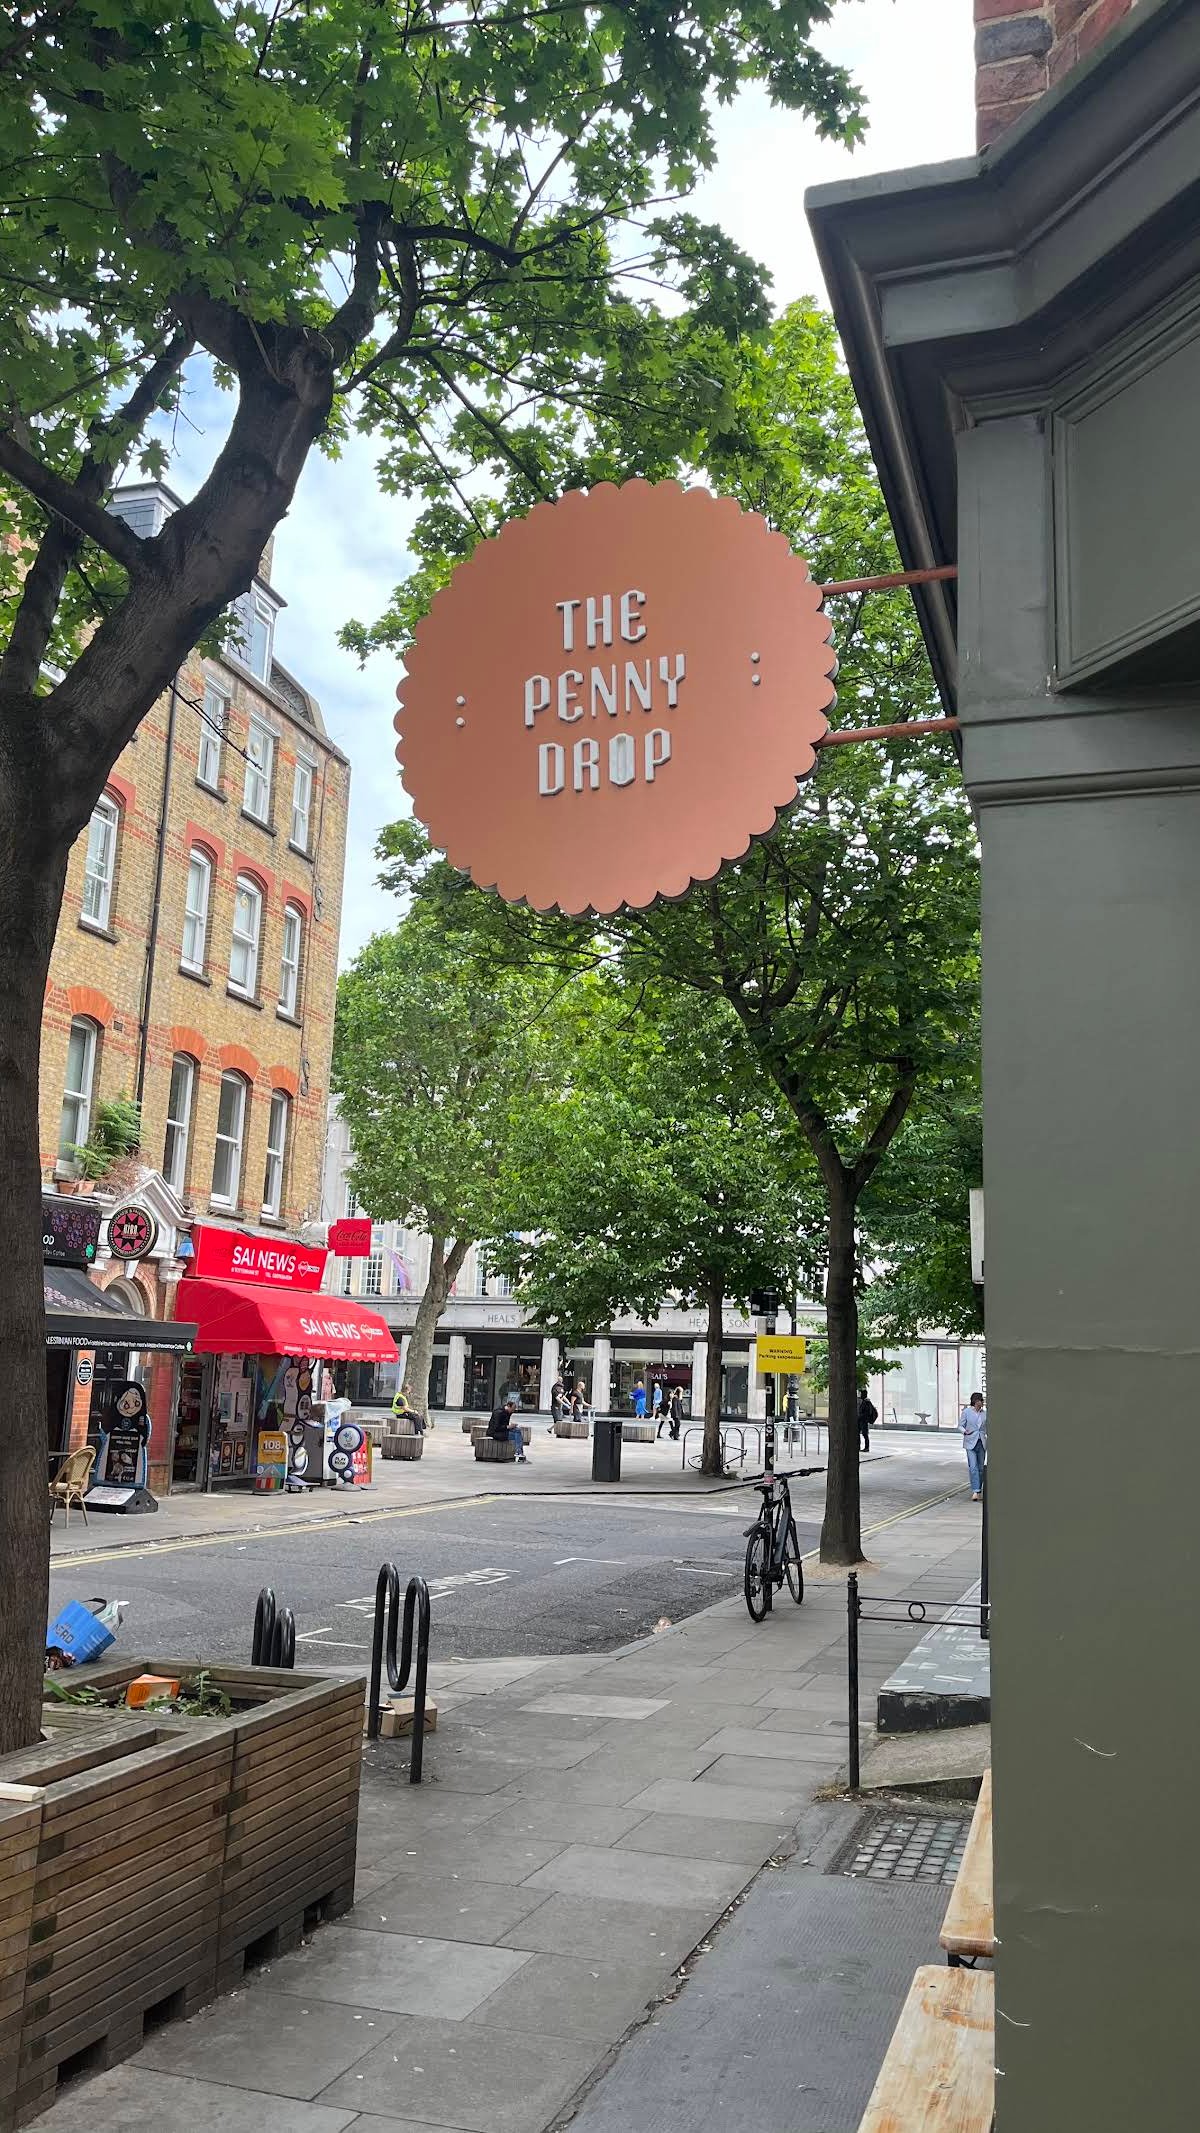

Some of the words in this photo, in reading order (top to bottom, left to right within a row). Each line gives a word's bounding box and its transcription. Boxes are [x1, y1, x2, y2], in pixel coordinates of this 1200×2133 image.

[556, 589, 647, 652] THE
[524, 653, 687, 728] PENNY
[538, 728, 672, 797] DROP
[232, 1245, 256, 1267] SAI
[257, 1250, 297, 1273] NEWS
[300, 1317, 324, 1336] SAI
[322, 1320, 361, 1340] NEWS
[689, 1317, 709, 1328] HEA
[729, 1319, 750, 1329] SON
[73, 1337, 89, 1346] FOOD
